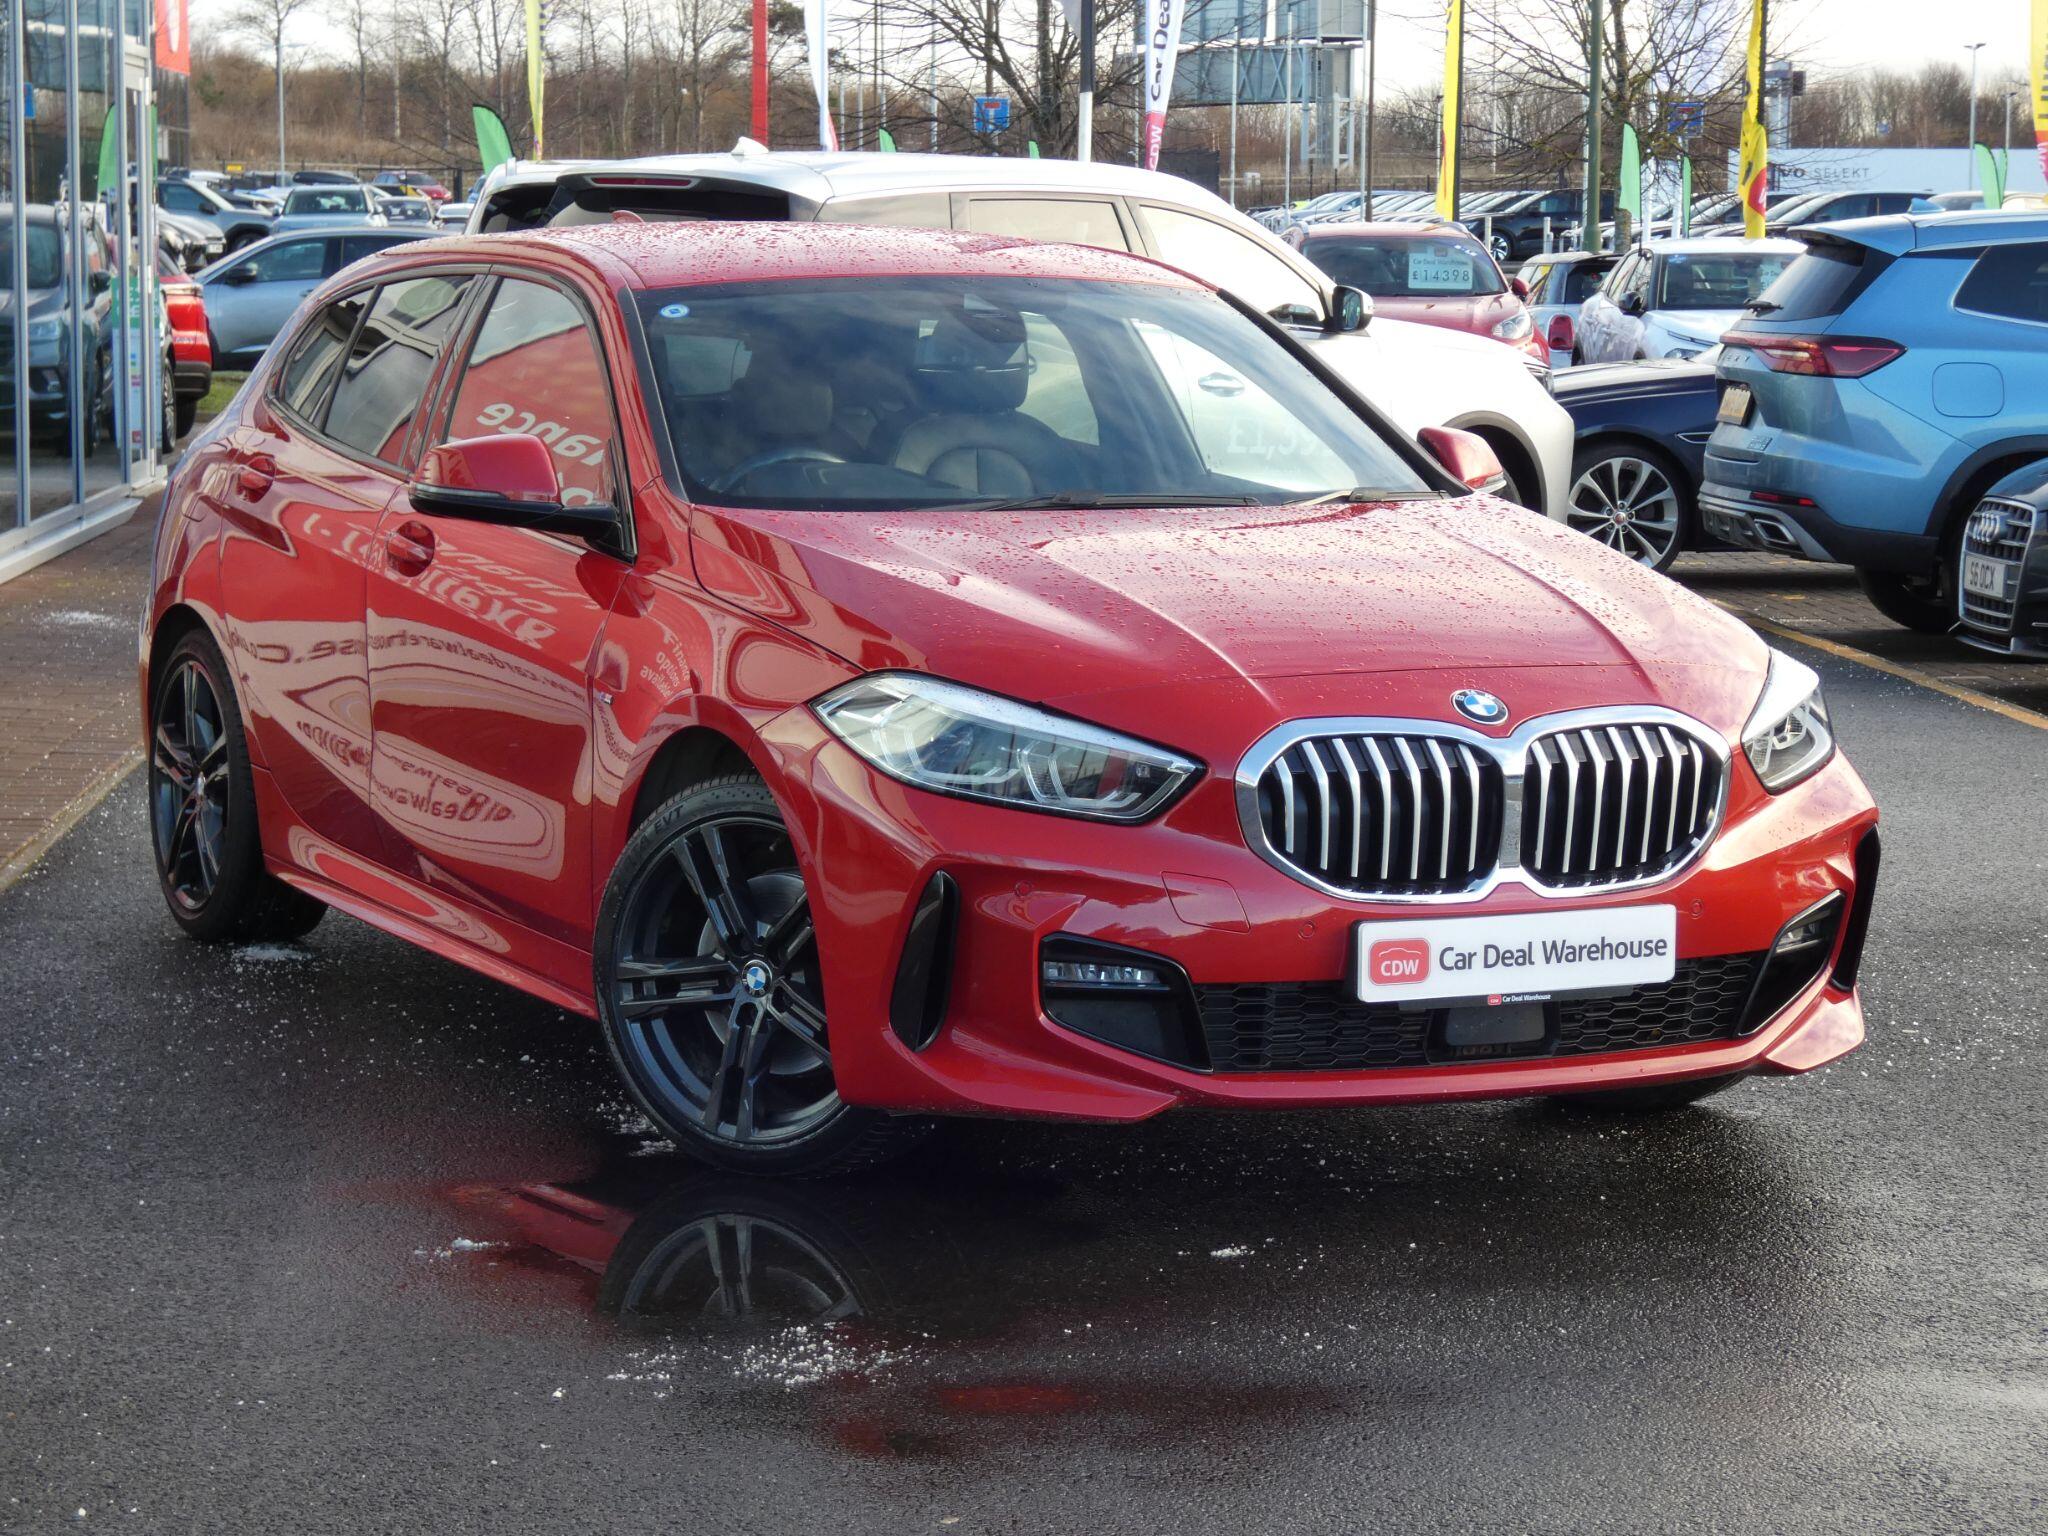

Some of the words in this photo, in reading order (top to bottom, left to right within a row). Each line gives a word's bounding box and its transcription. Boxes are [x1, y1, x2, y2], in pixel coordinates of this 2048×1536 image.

[1151, 57, 1163, 102] Car
[1813, 167, 1870, 179] SELEKT
[656, 651, 680, 687] options
[1380, 958, 1420, 978] CDW
[1439, 946, 1477, 972] Car
[1484, 941, 1535, 970] Deal
[1543, 936, 1668, 965] Warehouse
